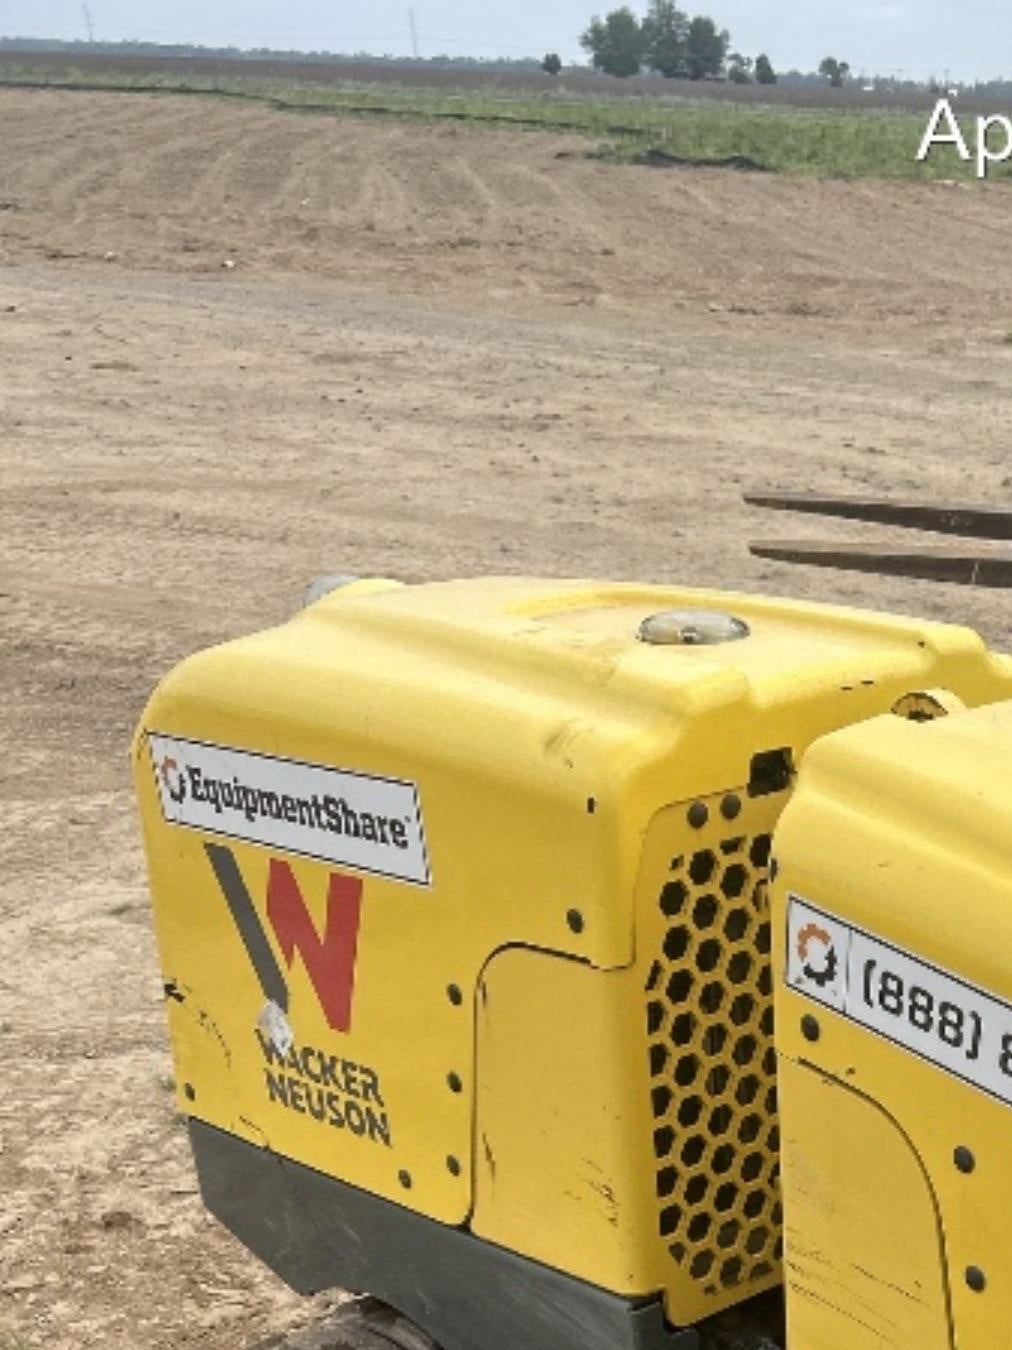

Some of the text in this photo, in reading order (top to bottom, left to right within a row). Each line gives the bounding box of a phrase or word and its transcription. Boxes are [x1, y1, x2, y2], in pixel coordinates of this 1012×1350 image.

[187, 765, 410, 849] EquipmentShare
[863, 958, 983, 1061] (888)
[254, 1027, 385, 1107] WACKER
[264, 1067, 394, 1149] NEUSON
